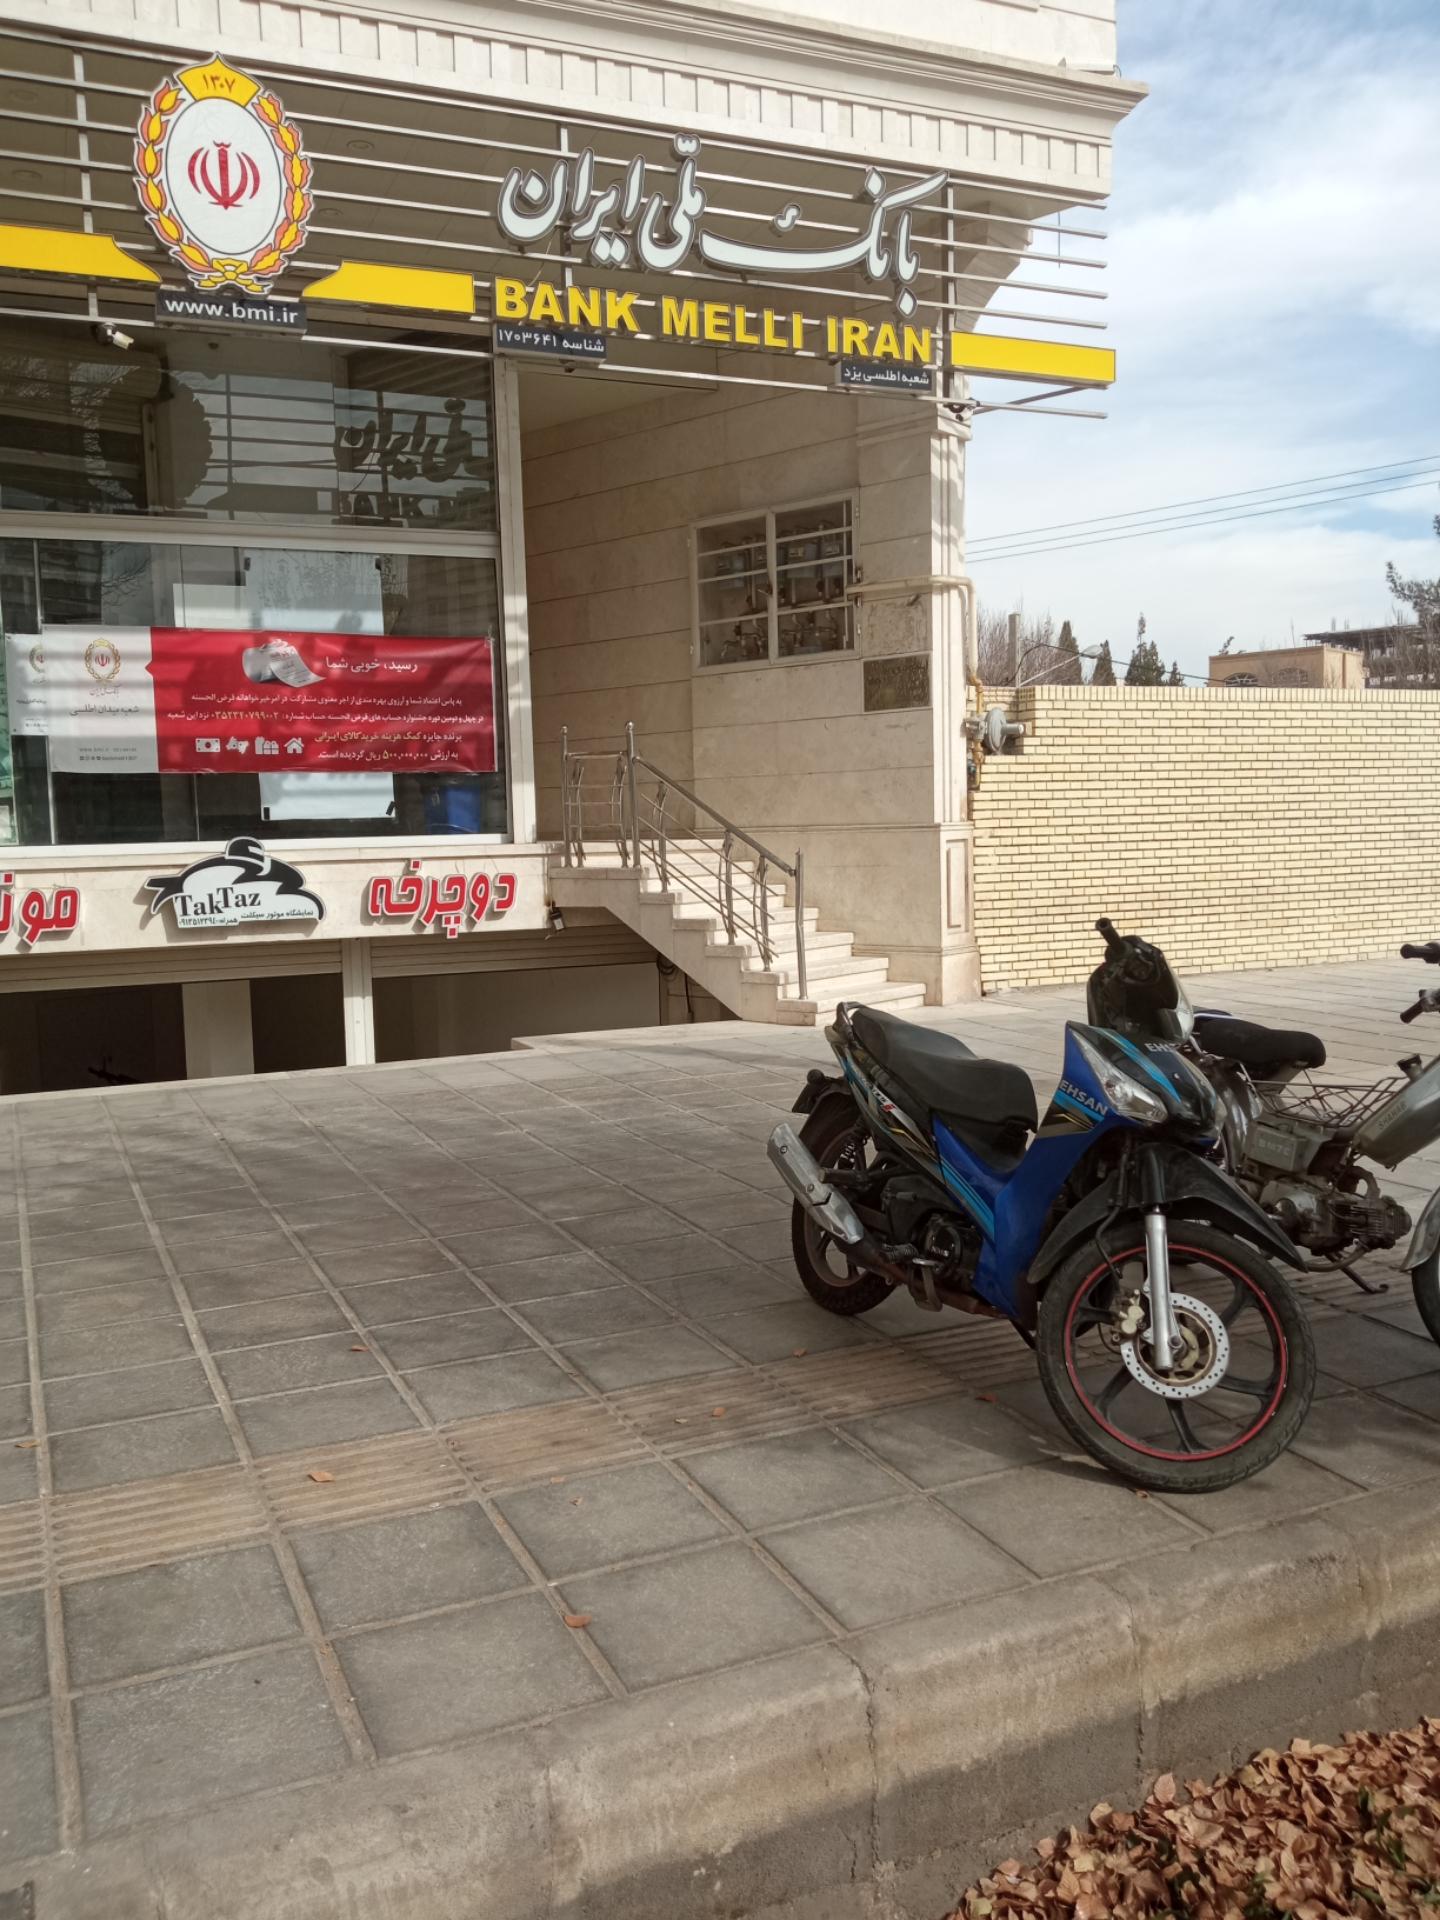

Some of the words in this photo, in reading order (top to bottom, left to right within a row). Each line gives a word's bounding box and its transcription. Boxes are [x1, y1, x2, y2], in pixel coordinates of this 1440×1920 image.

[202, 74, 236, 93] ۱۳۰۷
[497, 147, 645, 266] ایران
[164, 299, 299, 324] www.bmi.ir
[495, 277, 641, 333] BANK
[662, 295, 804, 352] MELLI
[826, 315, 931, 364] IRAN
[498, 329, 557, 348] ۱۷۰۳۶۴۱
[562, 338, 605, 353] شناسه
[844, 366, 862, 380] یزد
[863, 369, 901, 382] اطلسی
[901, 371, 929, 386] شعبه
[326, 656, 349, 668] شما
[351, 658, 380, 673] خوبی
[403, 731, 422, 740] کمک
[369, 859, 517, 940] دوچرخه
[266, 911, 284, 920] موتور
[286, 909, 314, 917] نمایشگاه
[1059, 1080, 1108, 1116] EHSAN
